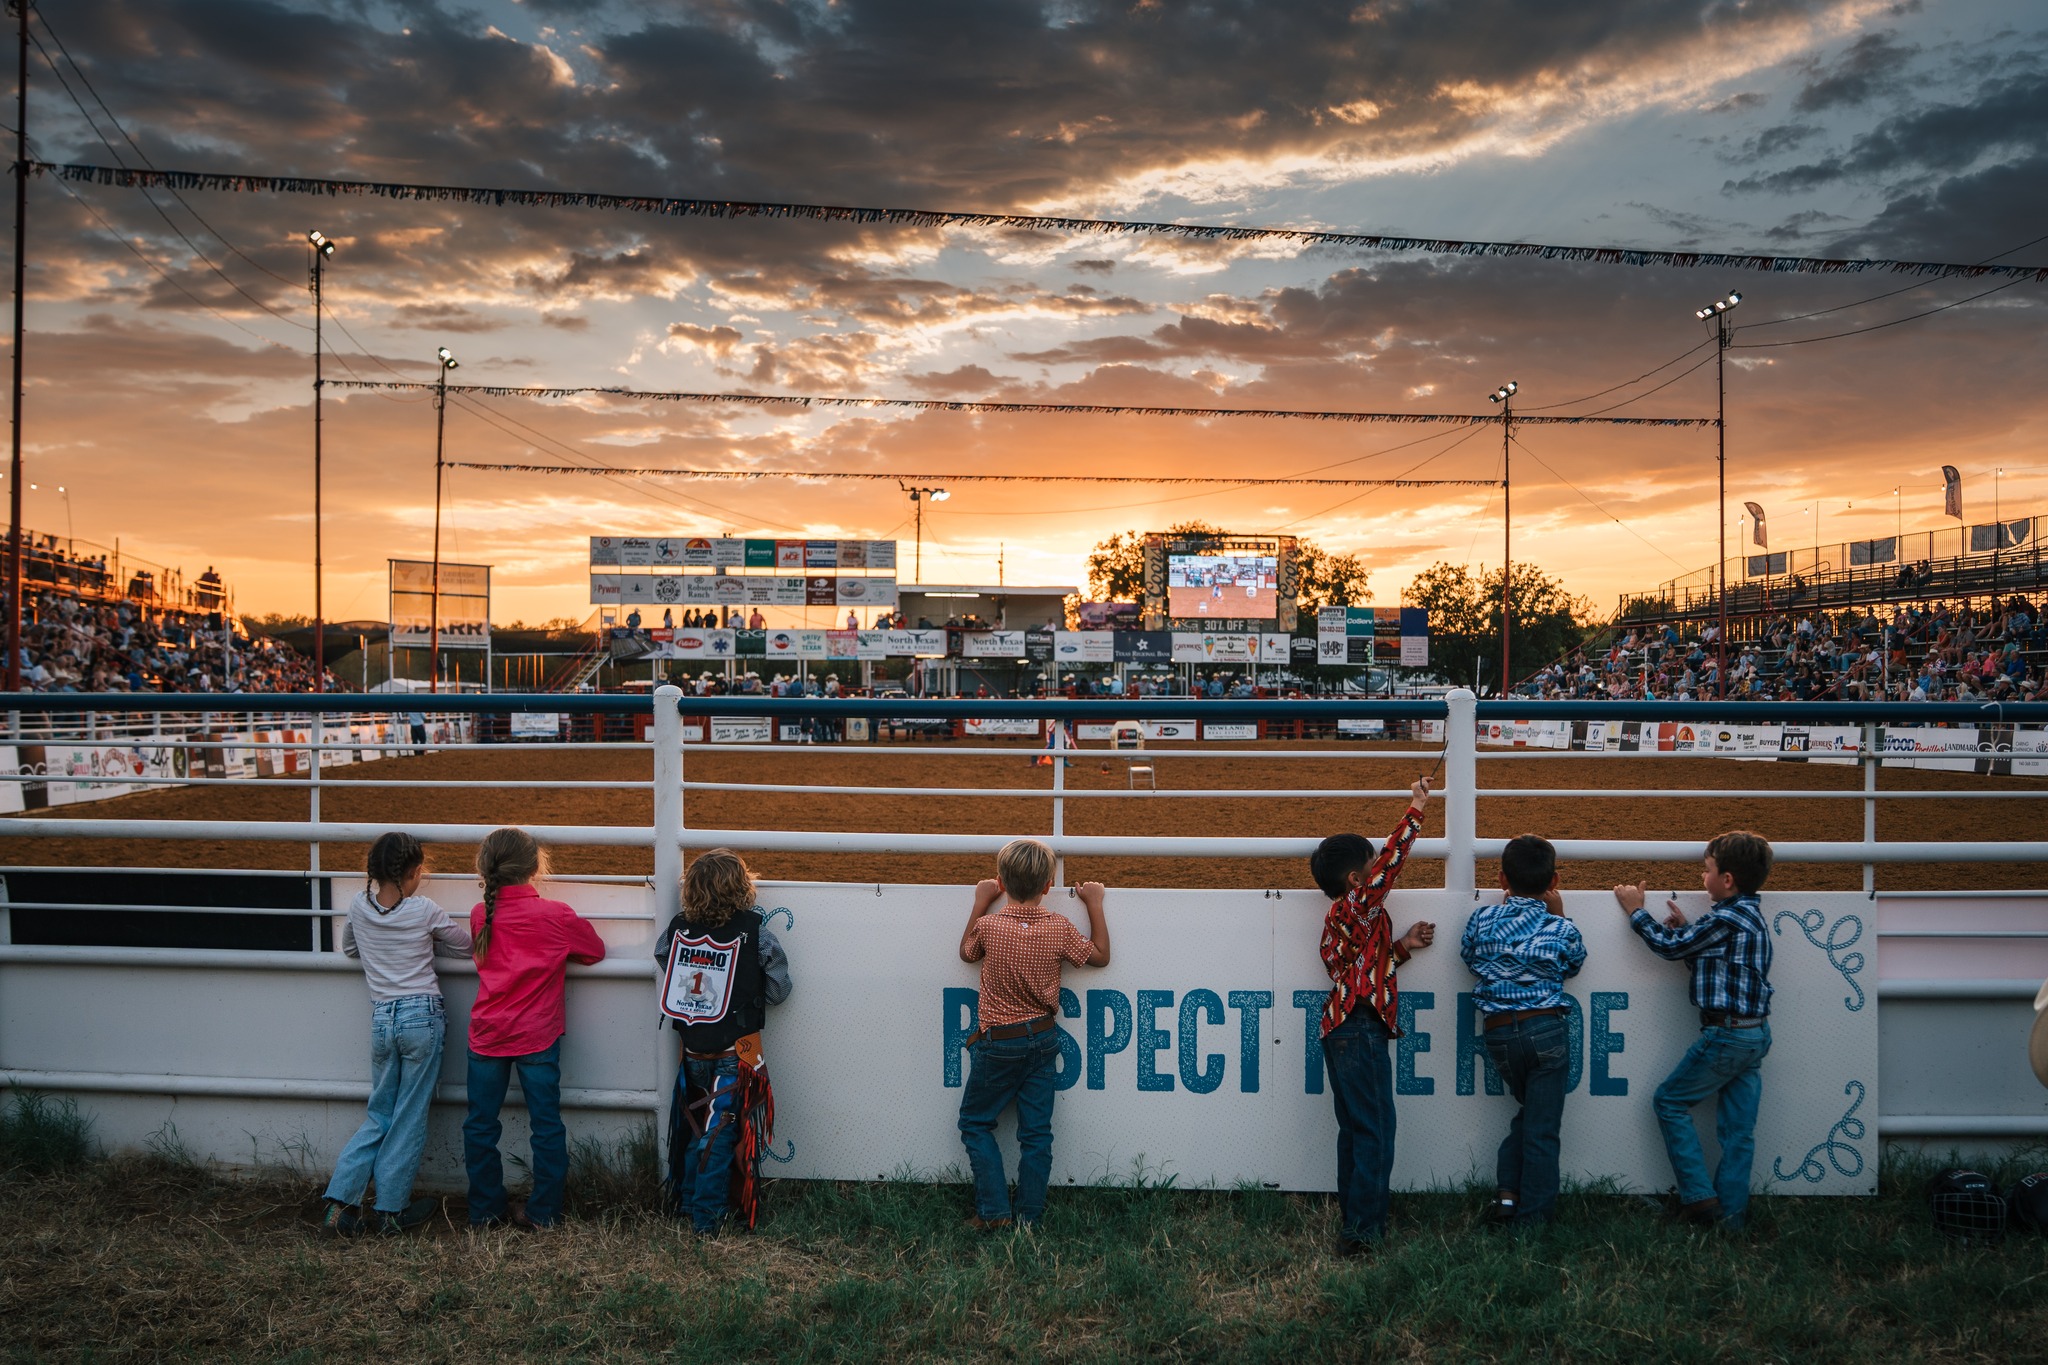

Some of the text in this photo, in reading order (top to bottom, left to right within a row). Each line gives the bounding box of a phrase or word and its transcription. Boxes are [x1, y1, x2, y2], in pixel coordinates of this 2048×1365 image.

[783, 552, 799, 561] ACE
[1278, 550, 1298, 599] Coors
[787, 579, 805, 587] DEF
[598, 585, 620, 594] Pyware
[1204, 620, 1225, 631] 30%
[1227, 620, 1244, 631] OFF
[888, 635, 914, 644] North
[972, 636, 998, 645] North
[1784, 736, 1808, 750] CAT
[1884, 738, 1915, 751] WOOD
[1944, 743, 1978, 752] LANDMARK
[73, 752, 84, 762] BIG
[73, 763, 90, 776] BULLY
[679, 947, 727, 967] RHINO
[690, 971, 704, 995] 1
[943, 986, 1272, 1095] RSPECT
[1293, 989, 1435, 1096] TE
